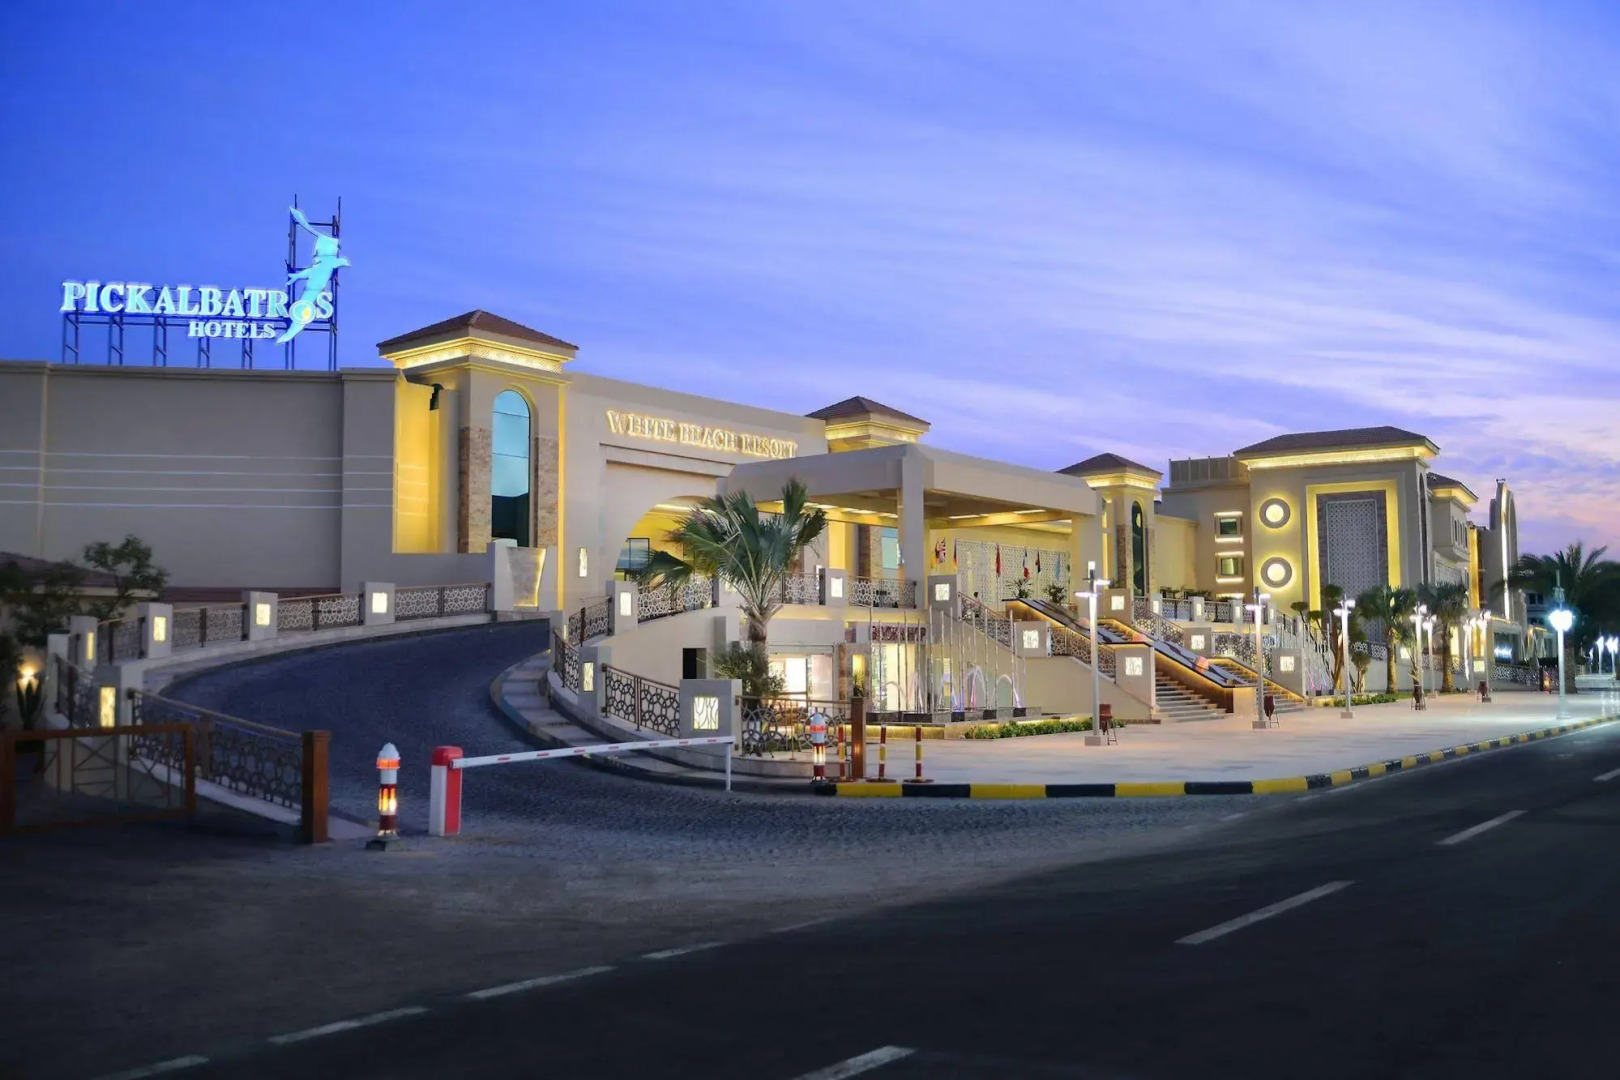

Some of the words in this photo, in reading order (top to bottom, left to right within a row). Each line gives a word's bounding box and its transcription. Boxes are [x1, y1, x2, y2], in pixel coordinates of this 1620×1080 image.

[61, 281, 334, 324] PICKALBATROS
[187, 321, 276, 339] HOTELS
[606, 410, 678, 442] WHITE
[679, 422, 739, 452] BEACH
[740, 433, 798, 459] RESORT
